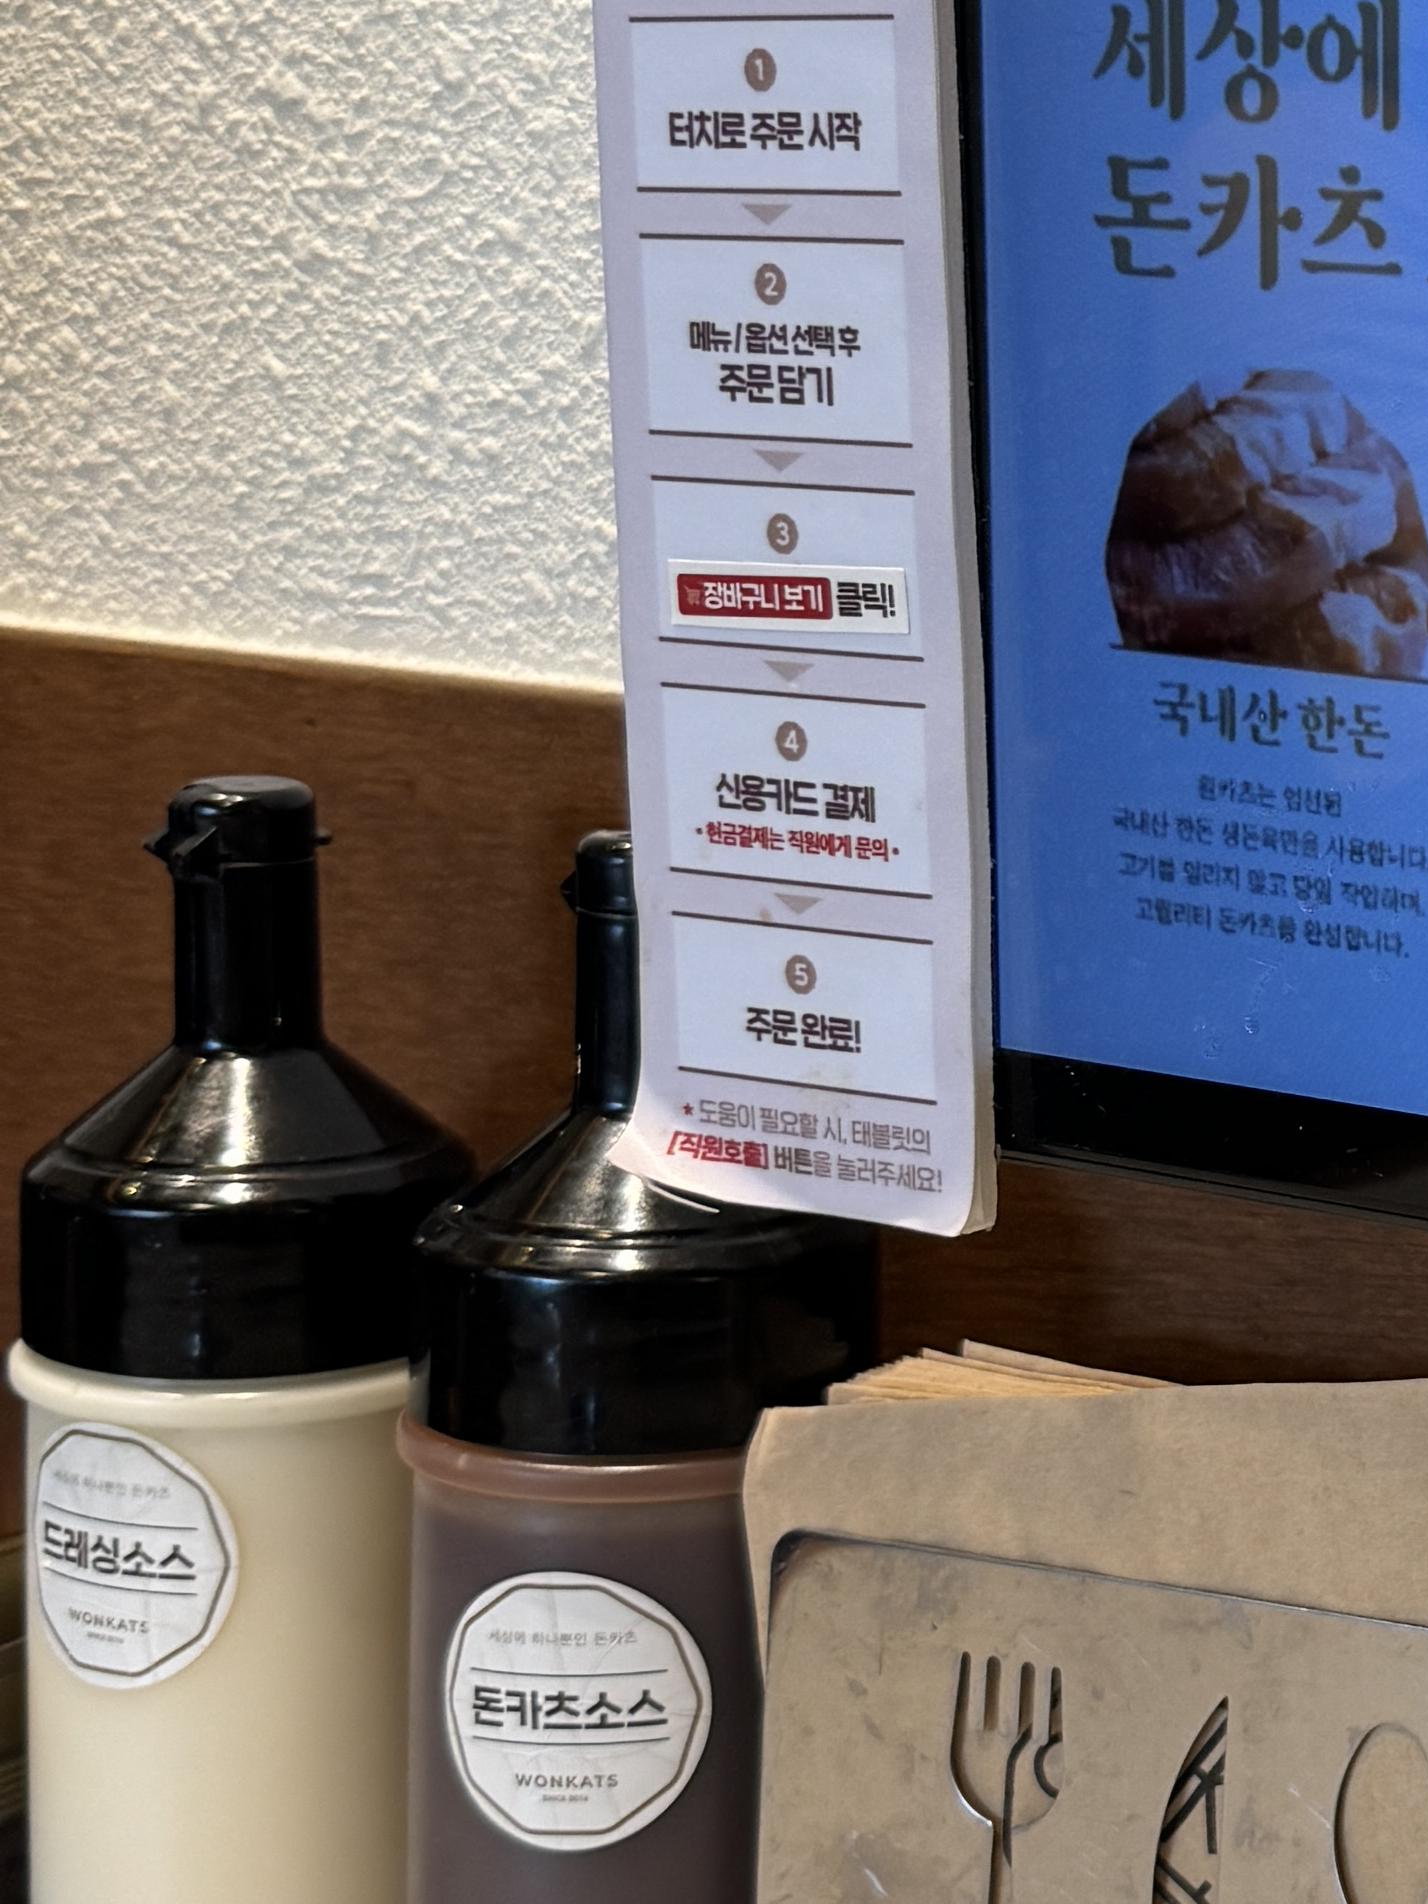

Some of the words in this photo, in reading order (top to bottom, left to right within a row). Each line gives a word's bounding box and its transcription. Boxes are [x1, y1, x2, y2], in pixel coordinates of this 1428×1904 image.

[668, 111, 747, 149] 터치로
[751, 112, 804, 150] 주문
[808, 111, 862, 151] 시작
[1093, 153, 1402, 292] 돈카츠
[791, 324, 835, 357] 선택
[719, 364, 774, 402] 주문
[777, 366, 834, 406] 담기
[703, 581, 779, 611] 장바구니
[784, 584, 824, 612] 보기
[837, 580, 896, 618] 클릭!
[1153, 681, 1288, 747] 국내산
[1298, 696, 1390, 760] 한돈
[715, 772, 819, 817] 신용카드
[824, 782, 876, 824] 결제
[787, 829, 853, 858] 직원에게
[855, 836, 889, 862] 문의
[745, 1007, 798, 1047] 주문
[801, 1011, 861, 1054] 완료!
[760, 1108, 819, 1142] 필요할
[852, 1119, 931, 1155] 태블릿의
[773, 1145, 831, 1178] 버튼을
[837, 1150, 943, 1193] 눌러주세요!
[42, 1519, 197, 1581] 드레싱소스
[68, 1607, 150, 1634] WONKATS
[472, 1684, 668, 1730] 돈카츠소스
[515, 1773, 618, 1789] WONKATS
